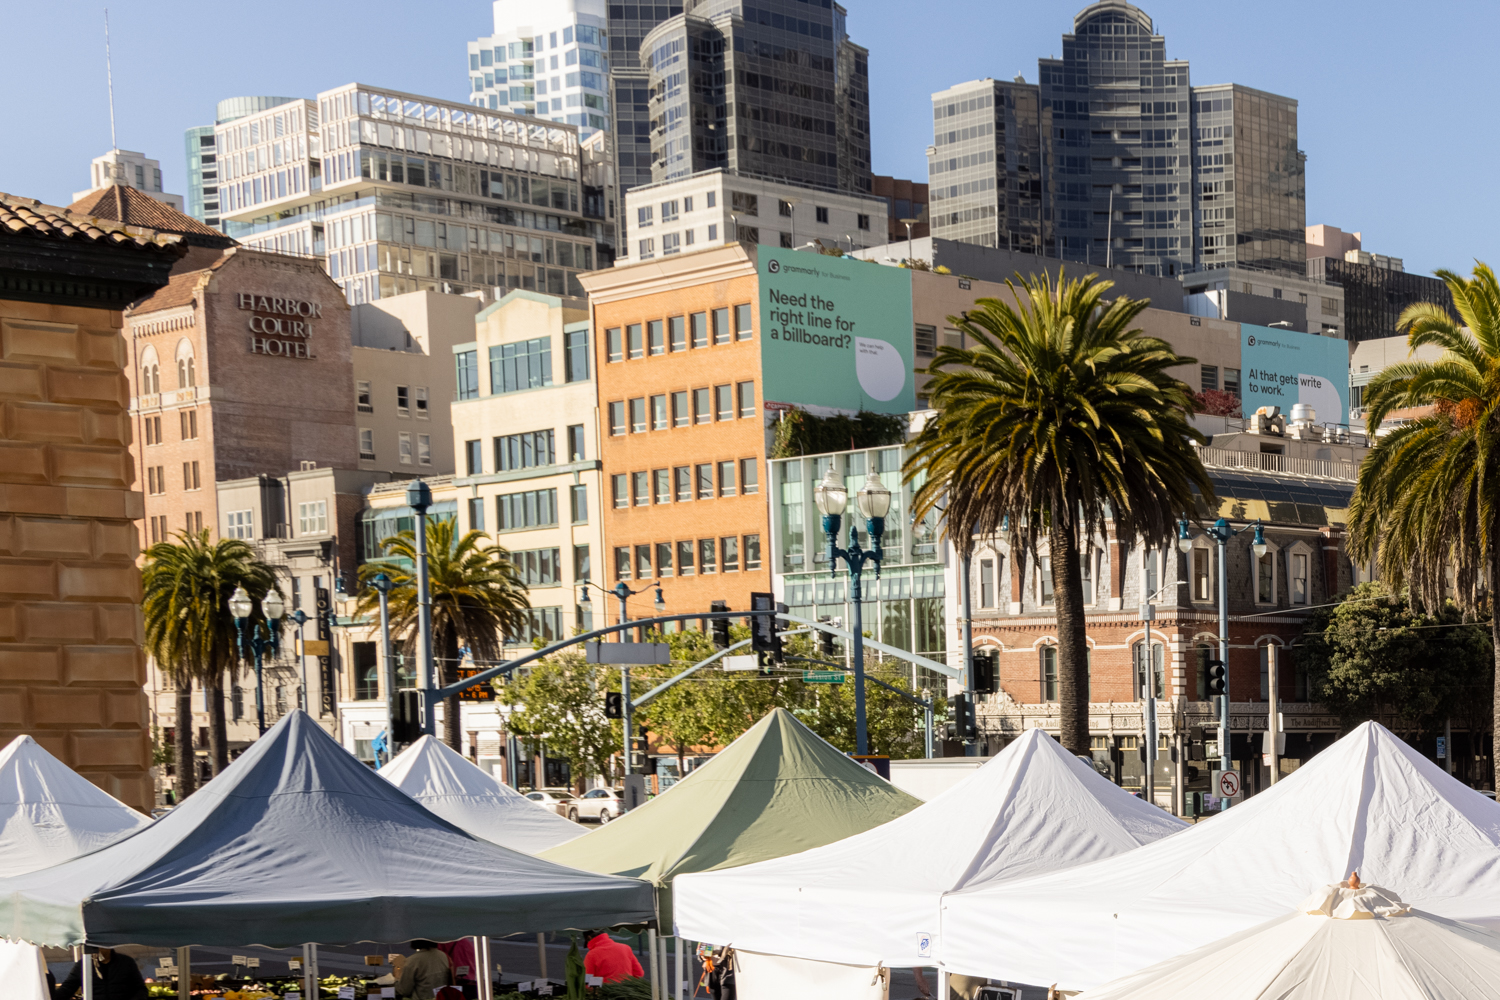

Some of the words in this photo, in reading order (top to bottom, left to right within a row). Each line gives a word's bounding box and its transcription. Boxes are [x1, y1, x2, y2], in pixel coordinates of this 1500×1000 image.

[783, 264, 820, 278] grammarly
[830, 272, 851, 281] Business
[238, 293, 323, 319] HARBOR
[769, 288, 807, 308] Need
[811, 295, 834, 311] the
[249, 316, 313, 339] COURT
[770, 307, 804, 326] right
[807, 311, 832, 329] line
[835, 316, 856, 332] for
[251, 337, 317, 360] HOTEL
[770, 328, 779, 340] a
[782, 326, 851, 349] billboard?
[875, 343, 884, 351] help
[1257, 339, 1281, 349] grammarly
[1249, 368, 1258, 379] AI
[1259, 370, 1278, 382] that
[1279, 374, 1298, 386] gets
[1300, 376, 1322, 388] write
[1249, 382, 1259, 393] to
[1260, 385, 1285, 396] work.
